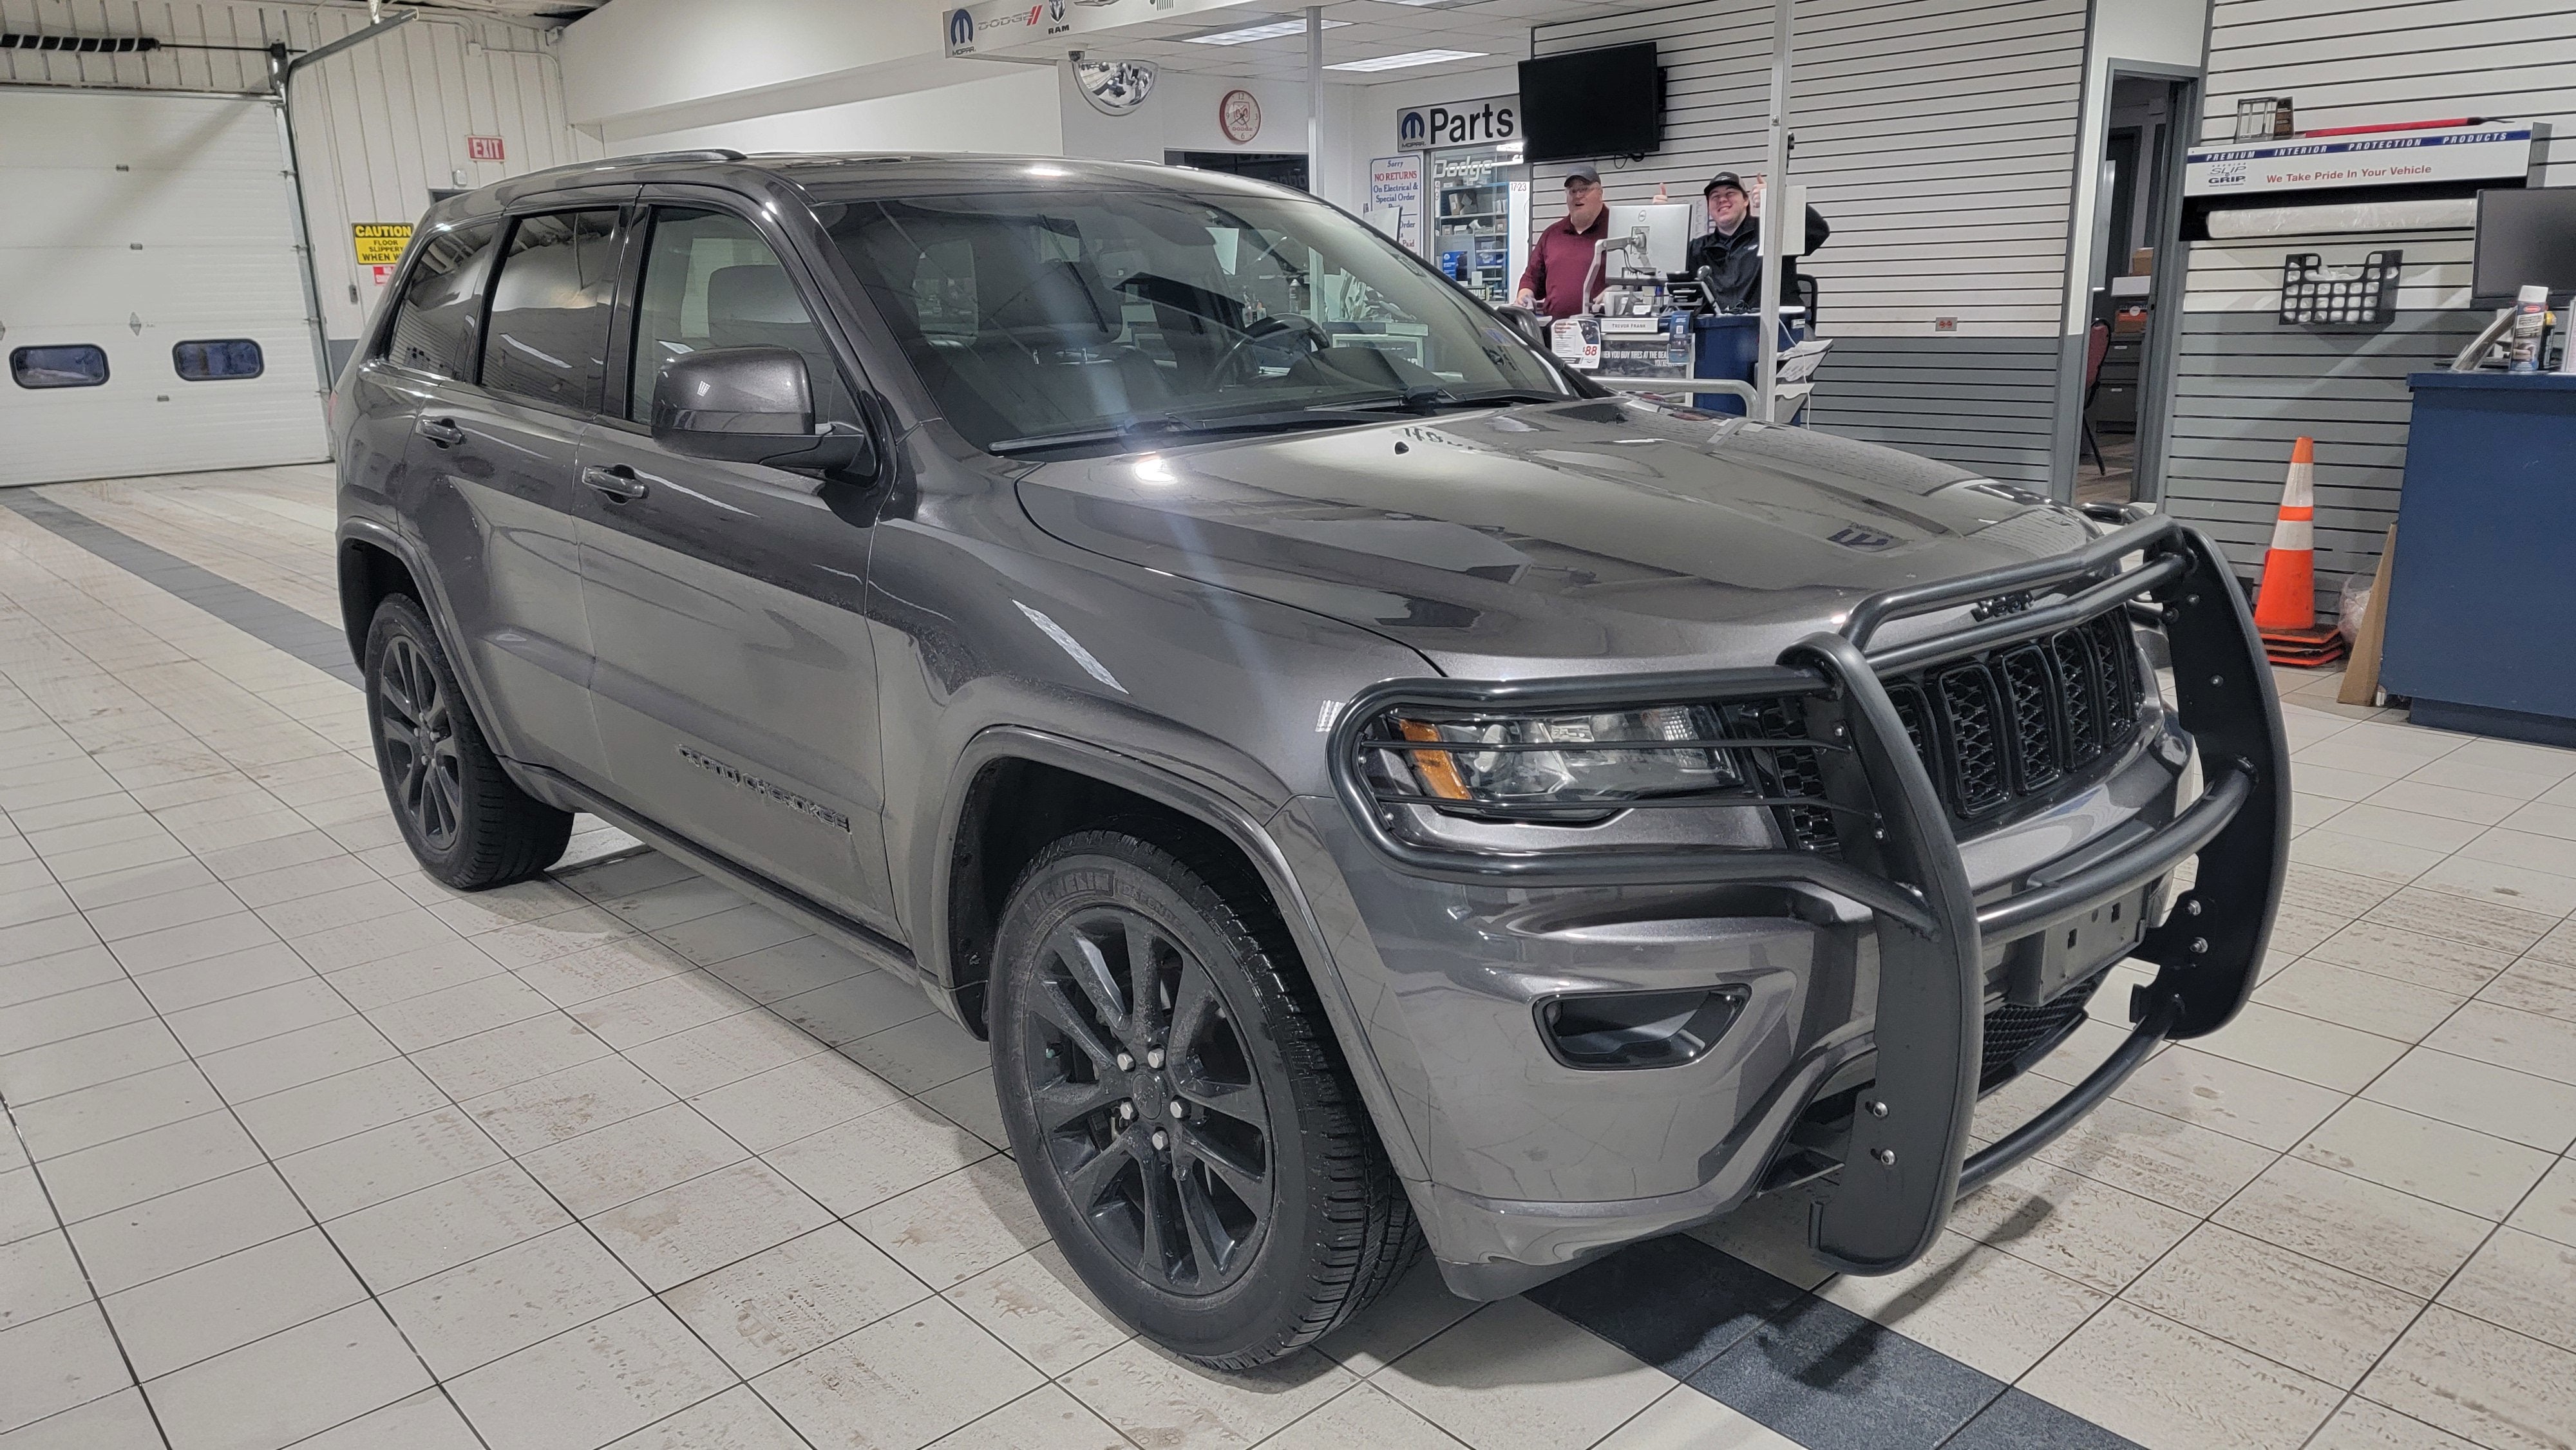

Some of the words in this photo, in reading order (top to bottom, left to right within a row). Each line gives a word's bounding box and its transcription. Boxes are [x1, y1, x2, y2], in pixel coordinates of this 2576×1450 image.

[978, 11, 1032, 30] DODGE
[1048, 24, 1070, 34] RAM
[1430, 104, 1514, 144] Parts
[473, 138, 500, 158] EXIT
[2206, 151, 2256, 162] PREMIUM
[2274, 145, 2327, 156] INTERIOR
[2348, 138, 2422, 151] PROTECTION
[2442, 132, 2508, 145] PRODUCTS
[1374, 173, 1385, 182] NO
[1385, 171, 1417, 181] RETURNS
[1433, 156, 1493, 181] Dodge
[2266, 174, 2283, 184] We
[2286, 172, 2311, 182] Take
[2315, 170, 2344, 180] Pride
[2347, 169, 2358, 178] In
[2362, 167, 2387, 177] Your
[2390, 165, 2432, 175] Vehicle
[1384, 182, 1412, 192] Electrical
[1376, 194, 1397, 203] Special
[355, 225, 412, 237] CAUTION
